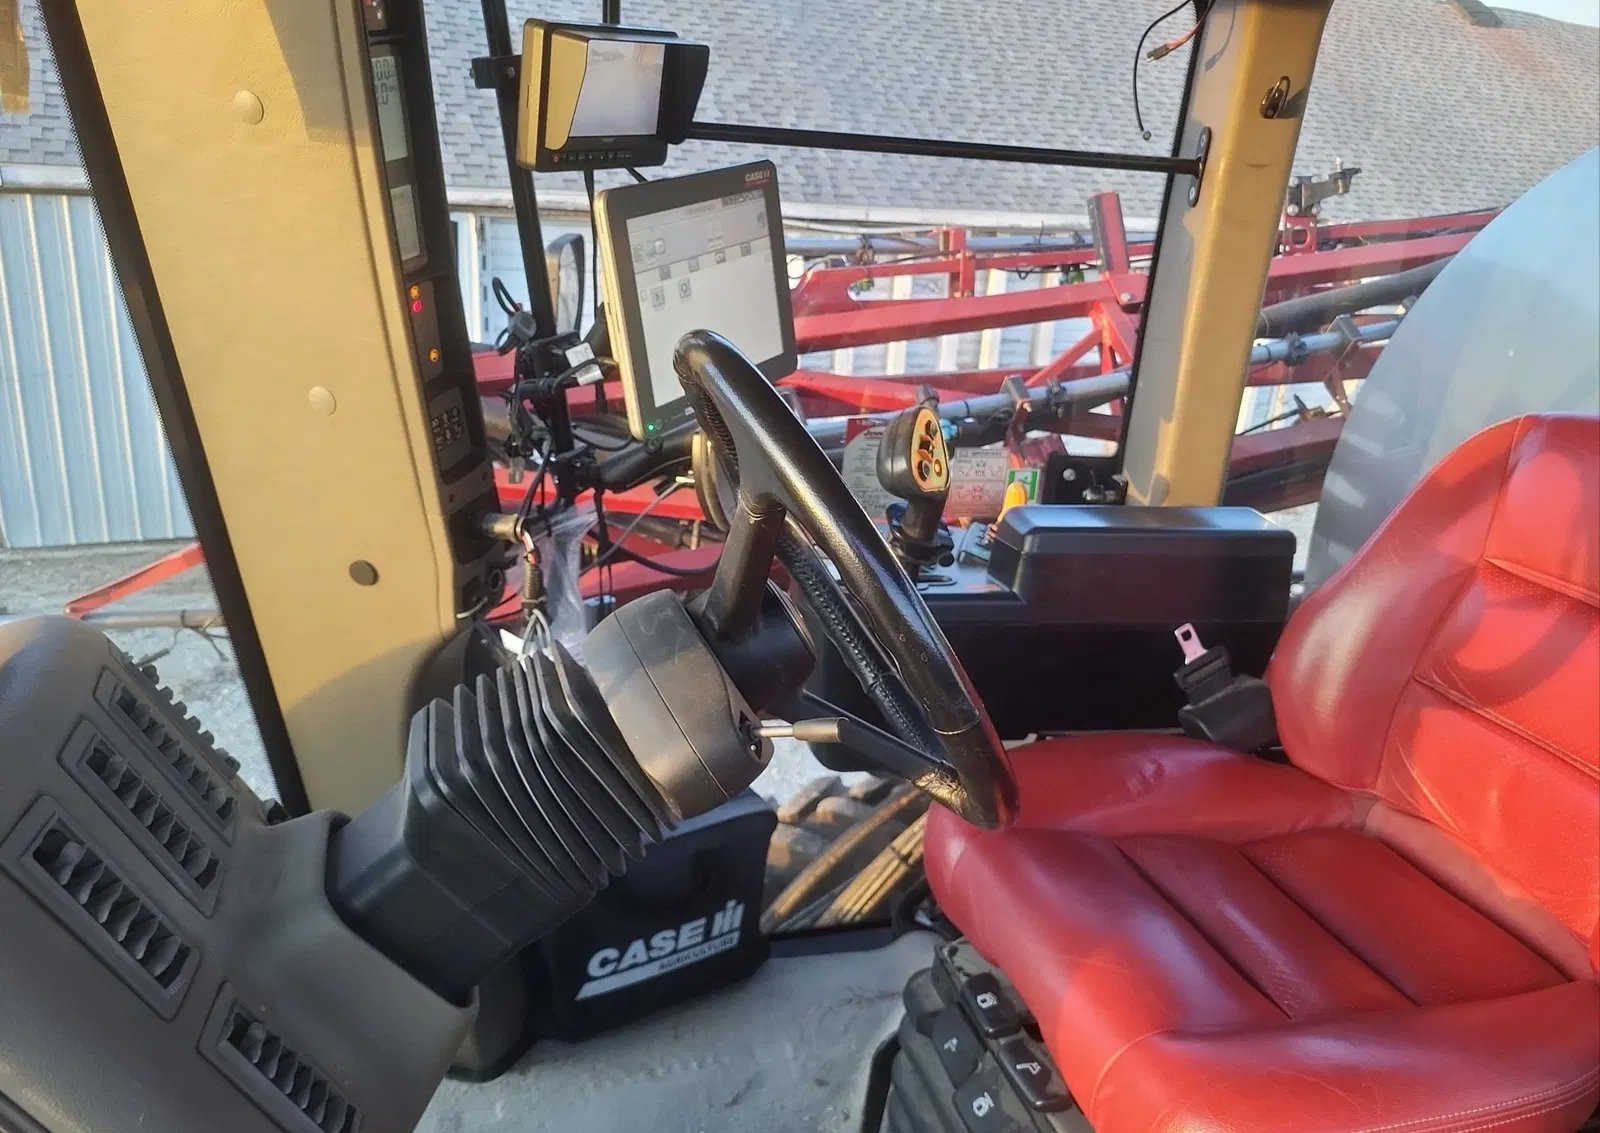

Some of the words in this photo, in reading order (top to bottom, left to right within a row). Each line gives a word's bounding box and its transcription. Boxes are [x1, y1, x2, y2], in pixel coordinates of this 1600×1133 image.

[744, 171, 763, 182] CASE
[586, 917, 706, 978] CASE
[658, 936, 734, 971] AGRICULTURE
